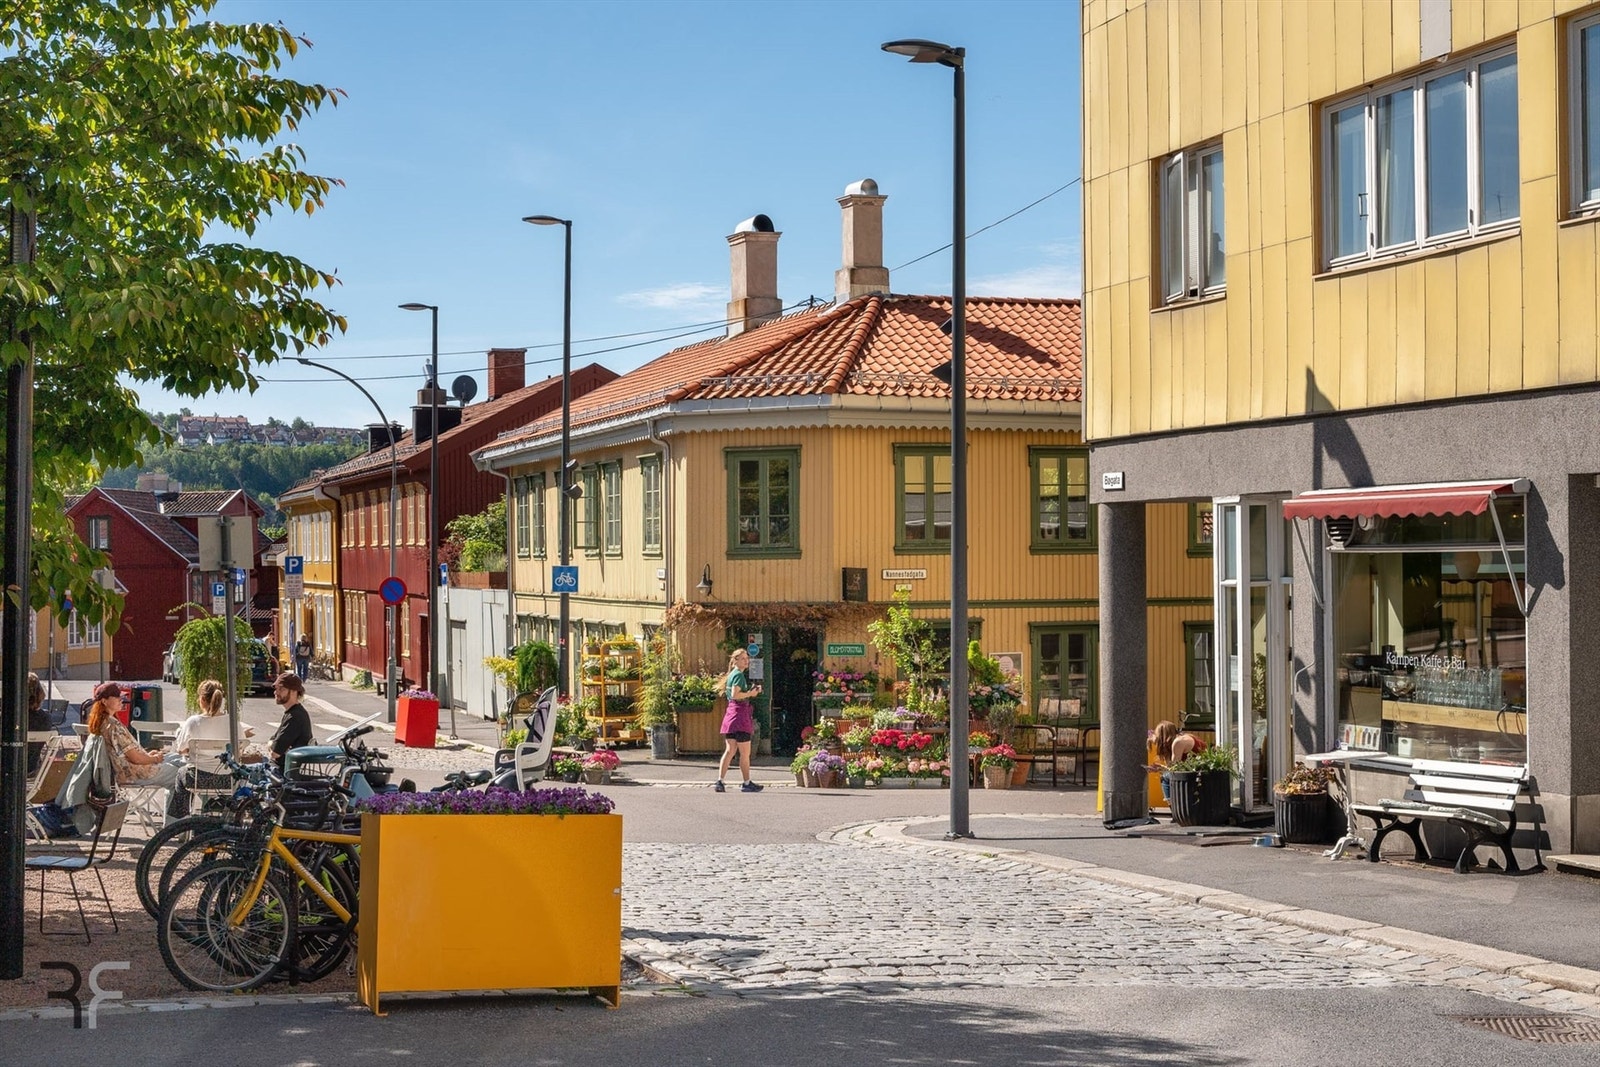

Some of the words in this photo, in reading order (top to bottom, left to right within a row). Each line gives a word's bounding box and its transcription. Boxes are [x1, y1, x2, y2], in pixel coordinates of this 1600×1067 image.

[289, 558, 299, 573] P
[886, 571, 924, 579] Nannestadgata
[216, 584, 224, 595] P
[1386, 651, 1419, 668] Kampen
[1420, 654, 1442, 667] Kaffe
[1443, 656, 1450, 668] &
[1451, 656, 1466, 669] Bar
